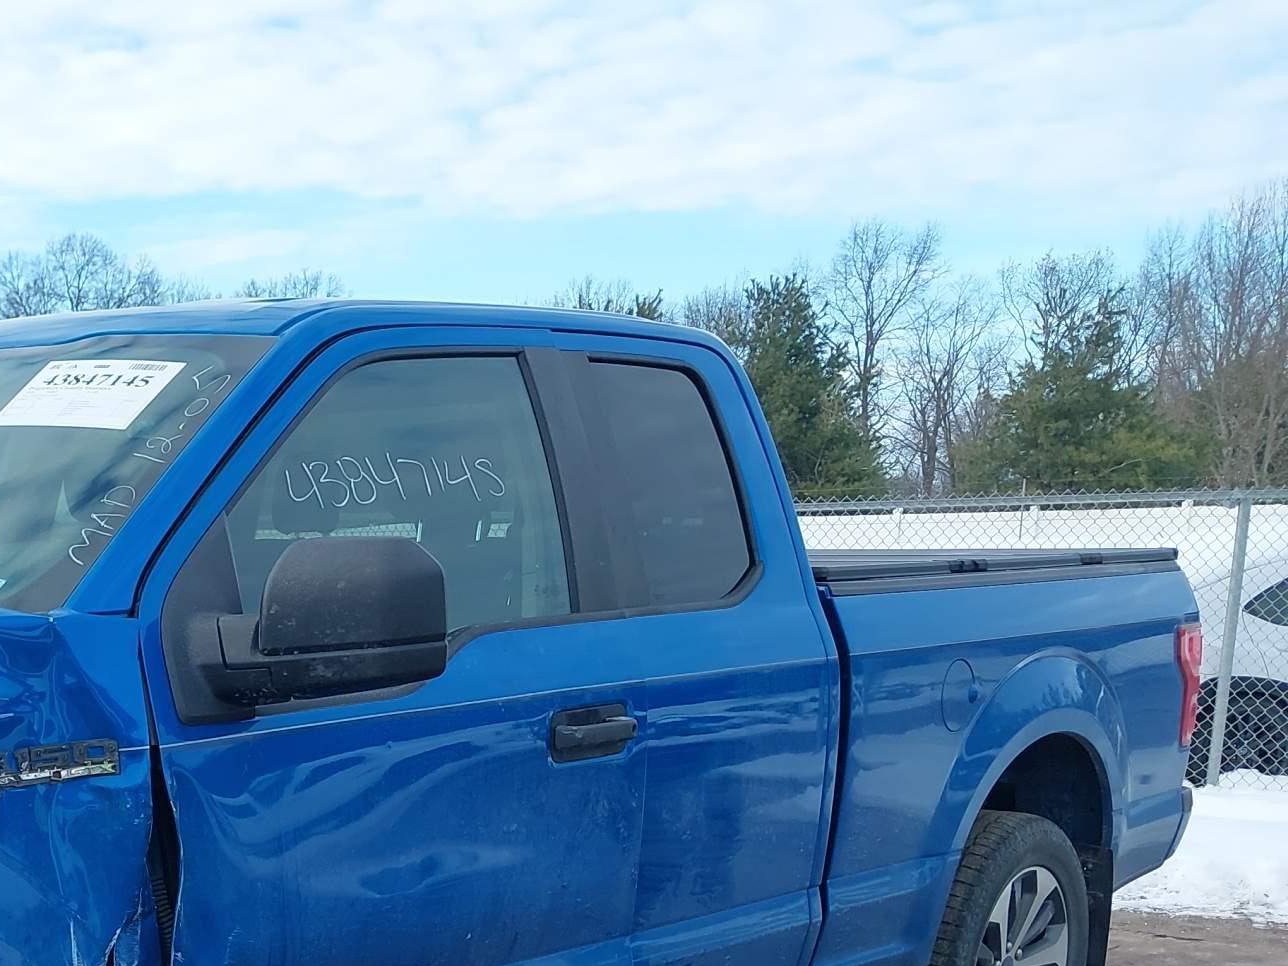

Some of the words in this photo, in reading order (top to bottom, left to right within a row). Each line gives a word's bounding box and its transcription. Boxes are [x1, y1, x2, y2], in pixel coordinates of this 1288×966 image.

[43, 373, 155, 388] 43847145
[284, 451, 506, 509] 43847145
[68, 485, 137, 566] MAD
